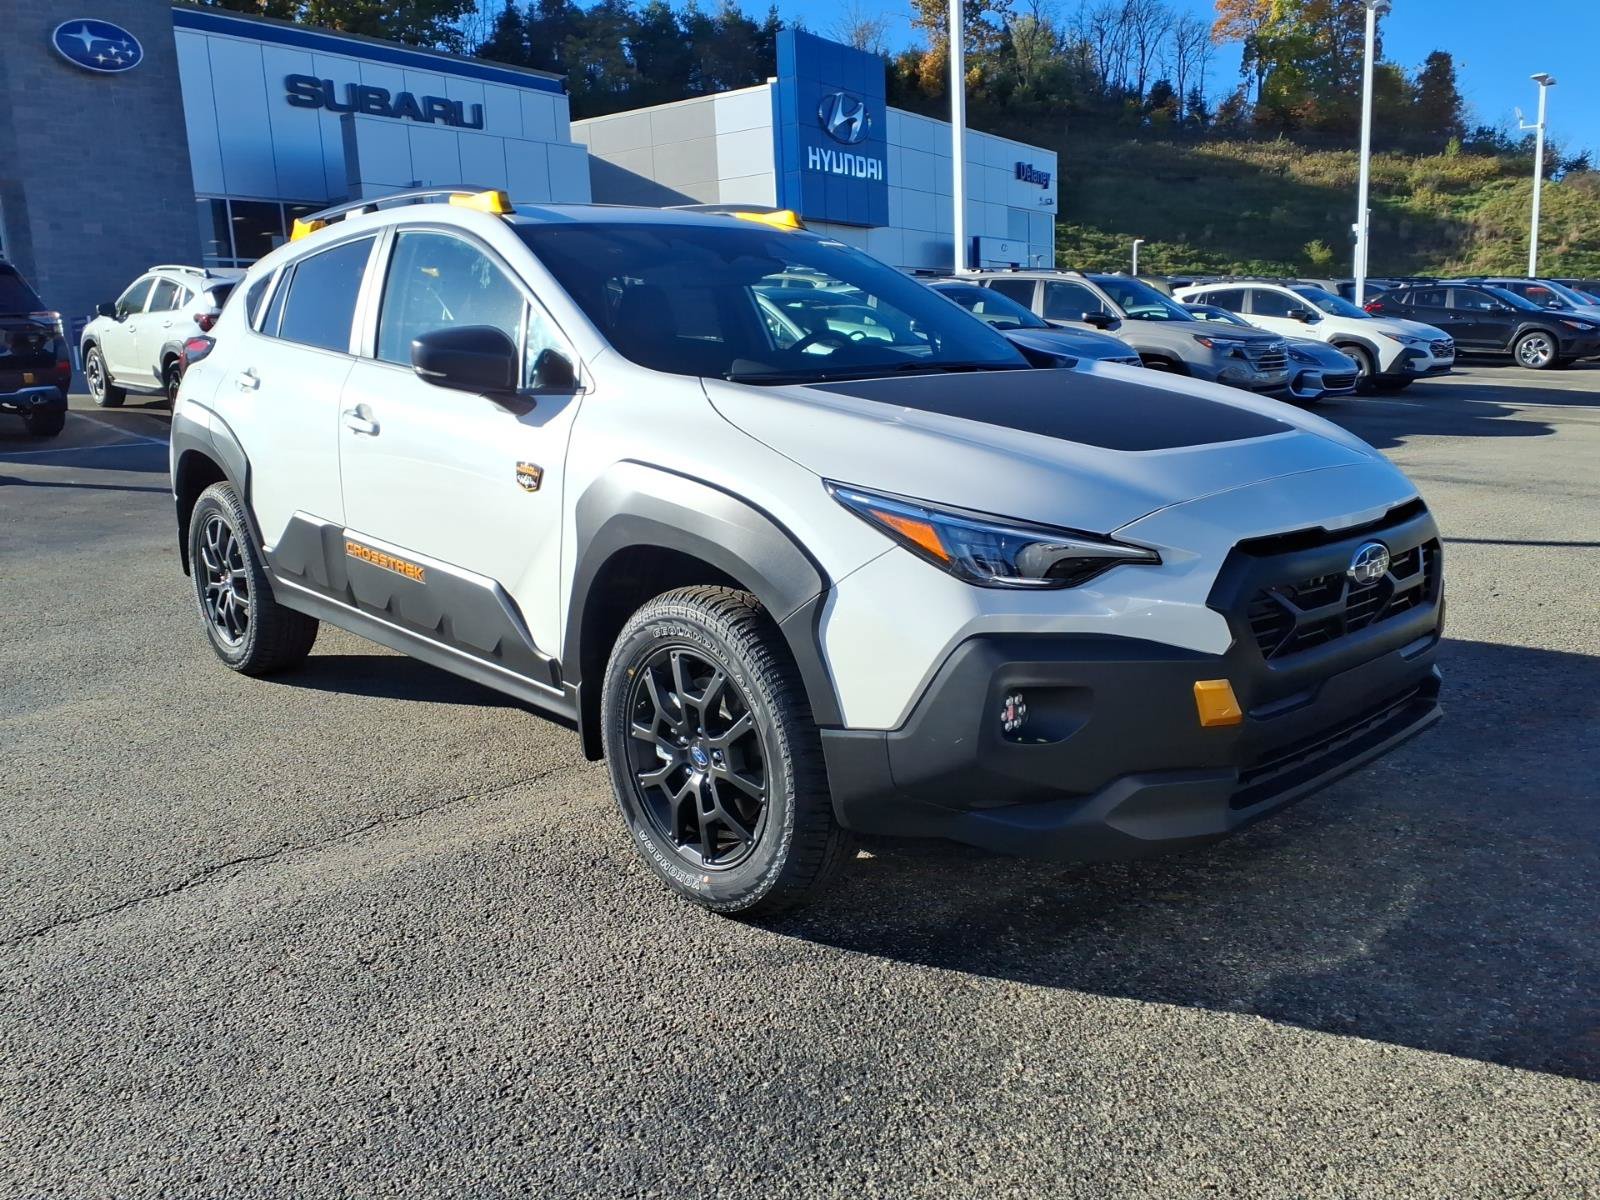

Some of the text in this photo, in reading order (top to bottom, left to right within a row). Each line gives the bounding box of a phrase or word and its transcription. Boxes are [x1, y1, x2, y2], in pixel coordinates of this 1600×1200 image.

[284, 74, 484, 130] SUBARU
[808, 146, 882, 180] HYUNDAI
[345, 541, 426, 582] CROSSTREK
[639, 830, 703, 890] YOKOHAMA
